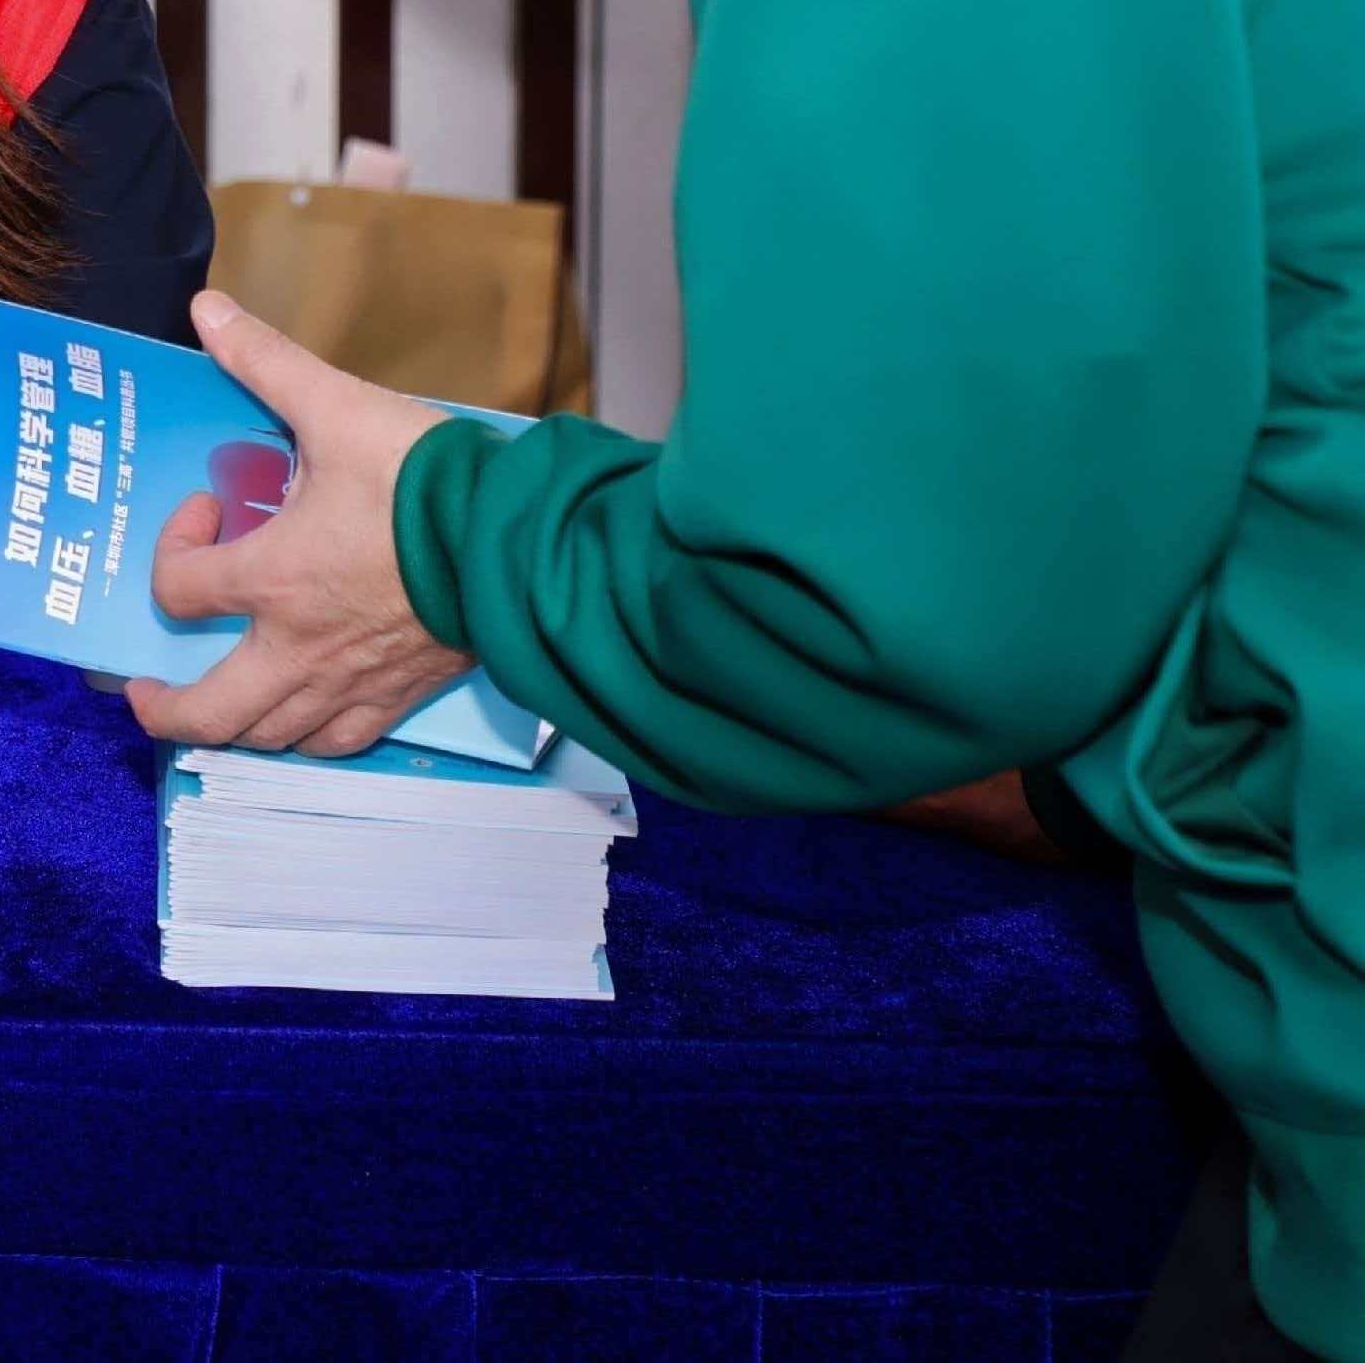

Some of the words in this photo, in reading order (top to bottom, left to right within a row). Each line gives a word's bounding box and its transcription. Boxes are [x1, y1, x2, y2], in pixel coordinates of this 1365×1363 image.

[4, 351, 55, 568] 如何科学管理
